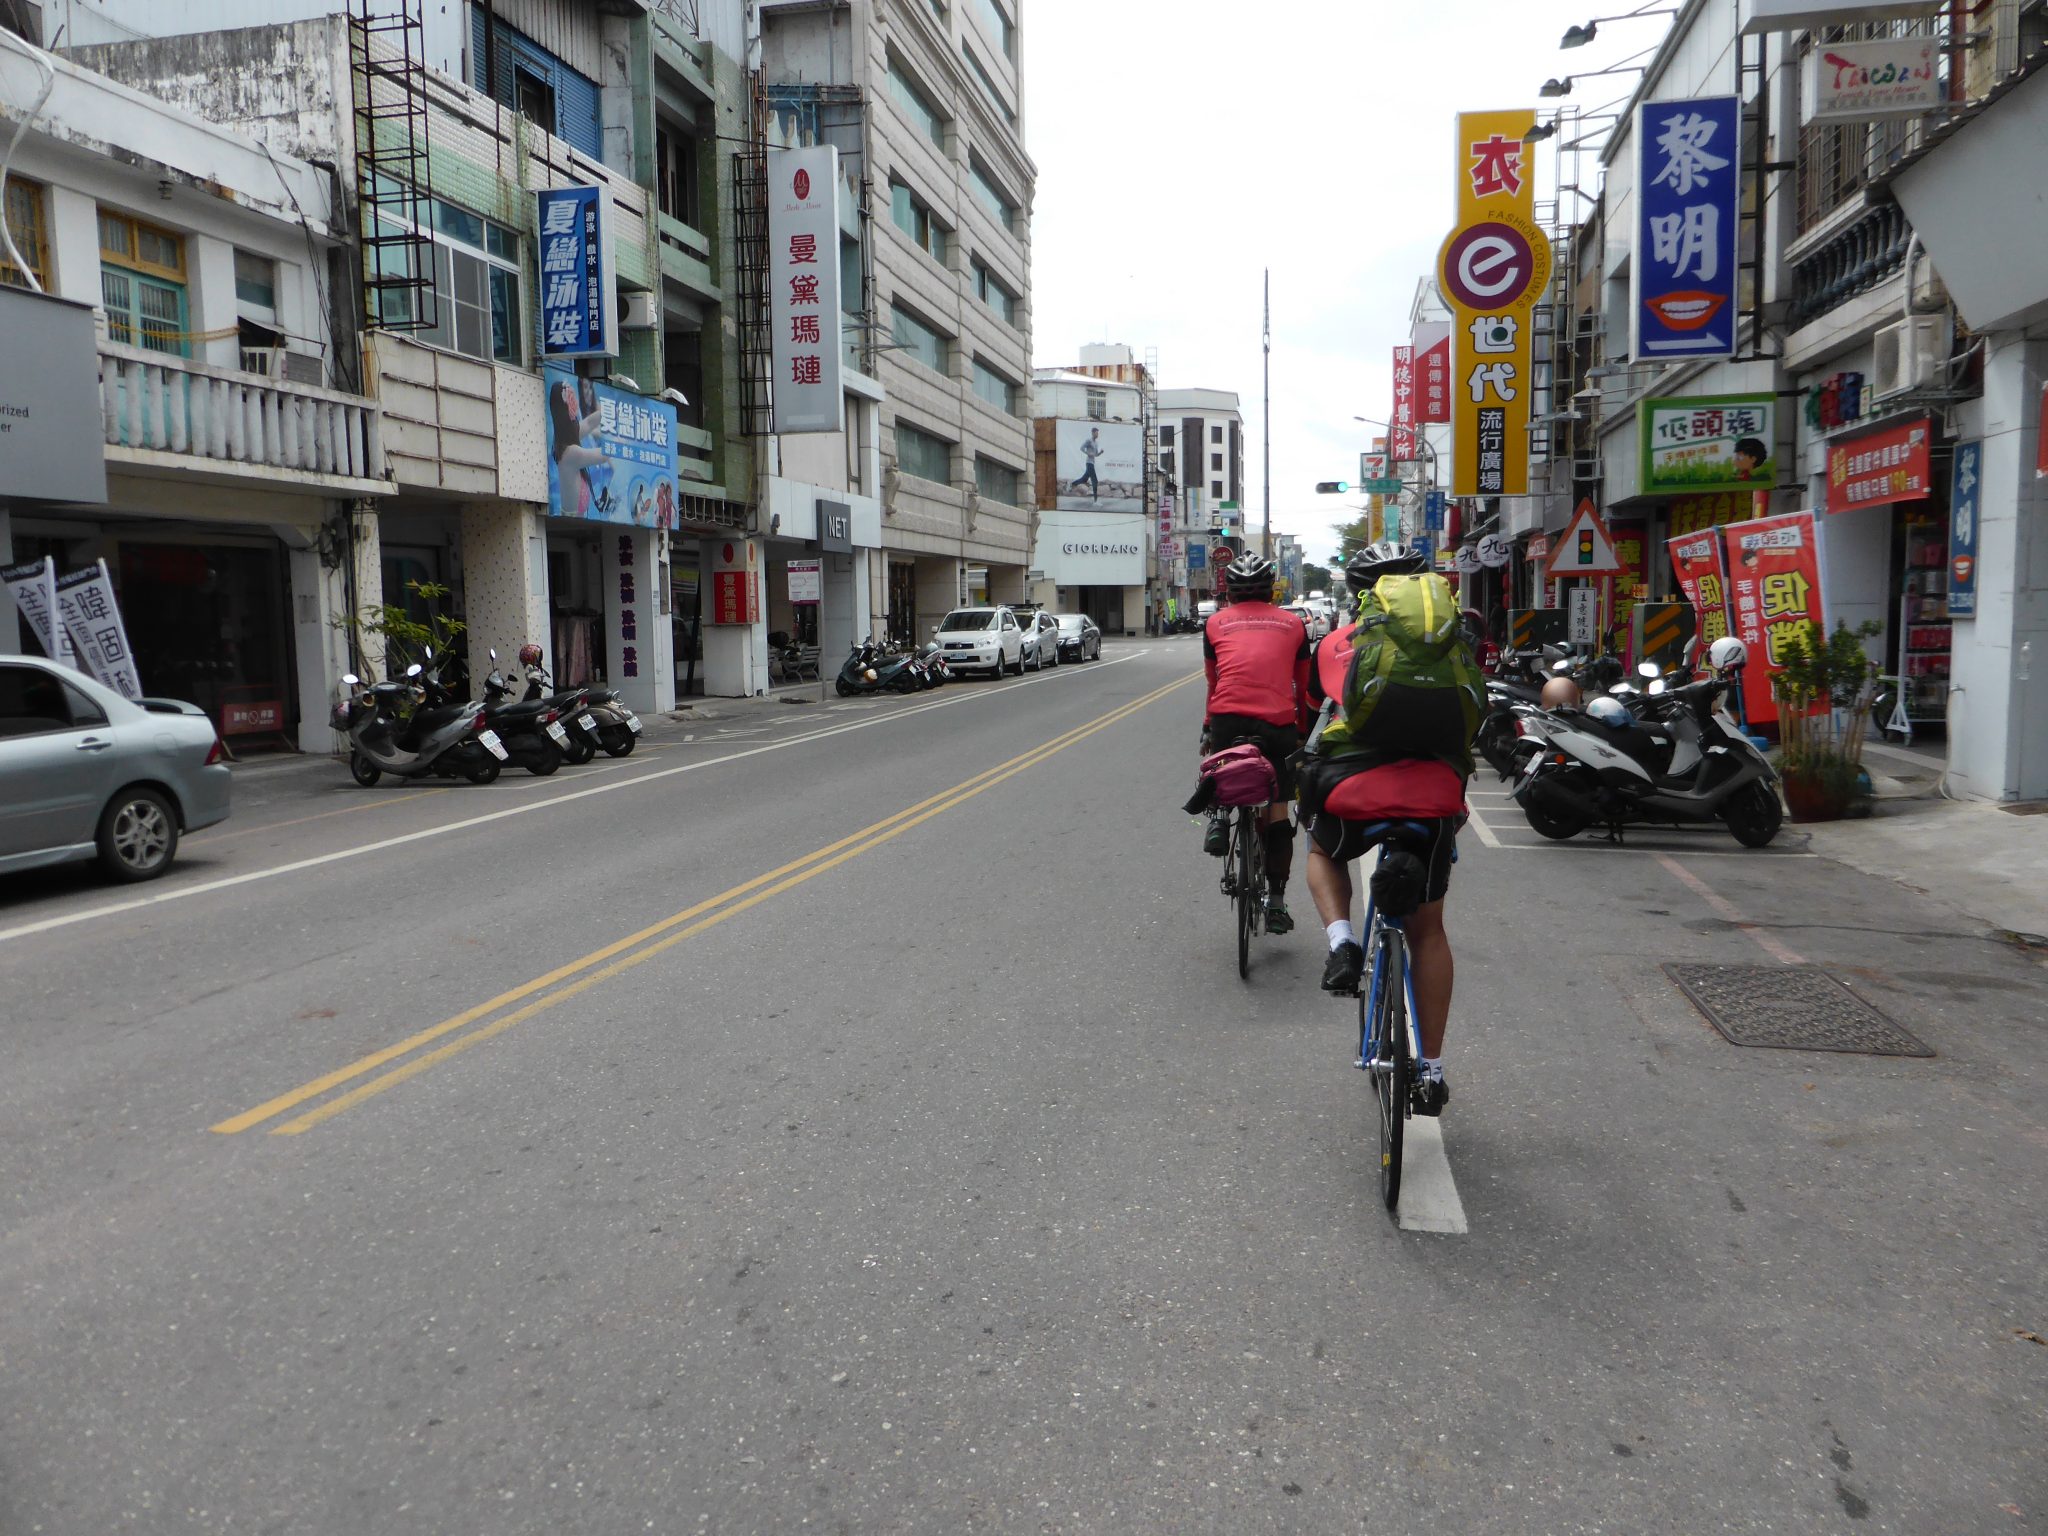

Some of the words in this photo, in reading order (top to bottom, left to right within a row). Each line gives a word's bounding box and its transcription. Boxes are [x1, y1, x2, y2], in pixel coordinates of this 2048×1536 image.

[1469, 134, 1524, 199] 衣
[1649, 112, 1730, 282] 黎明
[542, 199, 583, 345] 夏戀泳裝
[1458, 236, 1520, 297] e
[1487, 210, 1539, 241] FASHION
[1516, 243, 1546, 309] COSTUMES
[788, 234, 822, 385] 曼黛瑪璉
[1428, 353, 1443, 416] 遠傳電信
[1467, 315, 1518, 403] 世代
[599, 396, 669, 448] 夏戀泳裝
[1394, 346, 1413, 461] 明德中醫診所
[1658, 409, 1756, 441] 低頭族
[1366, 457, 1383, 479] 7
[1479, 411, 1502, 490] 流行廣場
[827, 514, 848, 539] NET
[1956, 447, 1977, 546] 黎明
[1062, 542, 1139, 555] GIORDANO
[1577, 591, 1589, 640] 注意號誌
